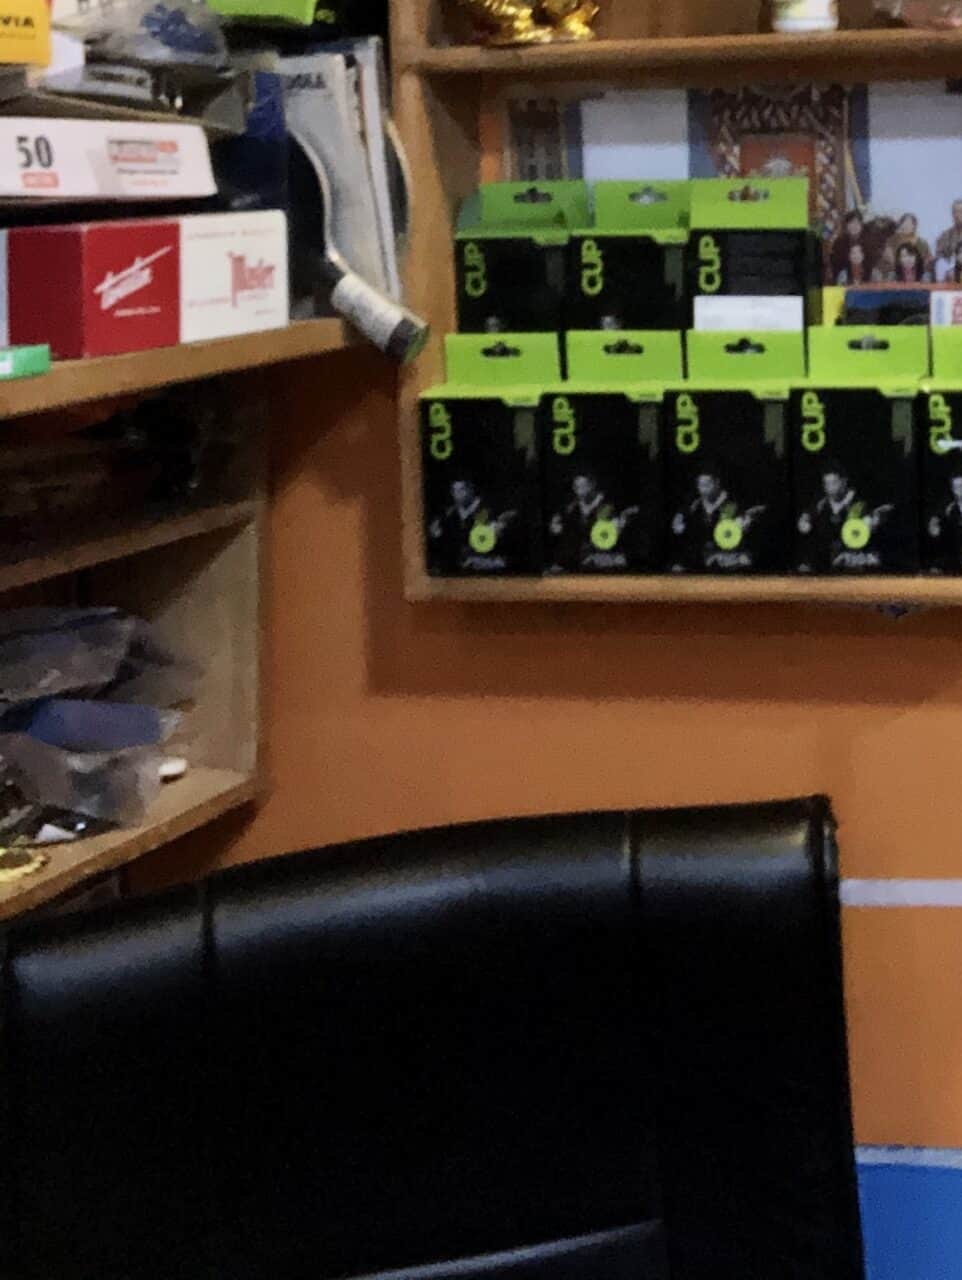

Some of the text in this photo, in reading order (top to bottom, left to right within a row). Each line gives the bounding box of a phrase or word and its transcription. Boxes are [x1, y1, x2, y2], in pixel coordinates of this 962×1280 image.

[16, 135, 54, 169] 50
[464, 242, 487, 297] CUP
[581, 239, 603, 296] CUP
[699, 235, 721, 292] CUP
[429, 403, 453, 459] CUP
[552, 397, 576, 455] CUP
[676, 393, 699, 453] CUP
[802, 392, 826, 452] CUP
[929, 394, 952, 454] CUP
